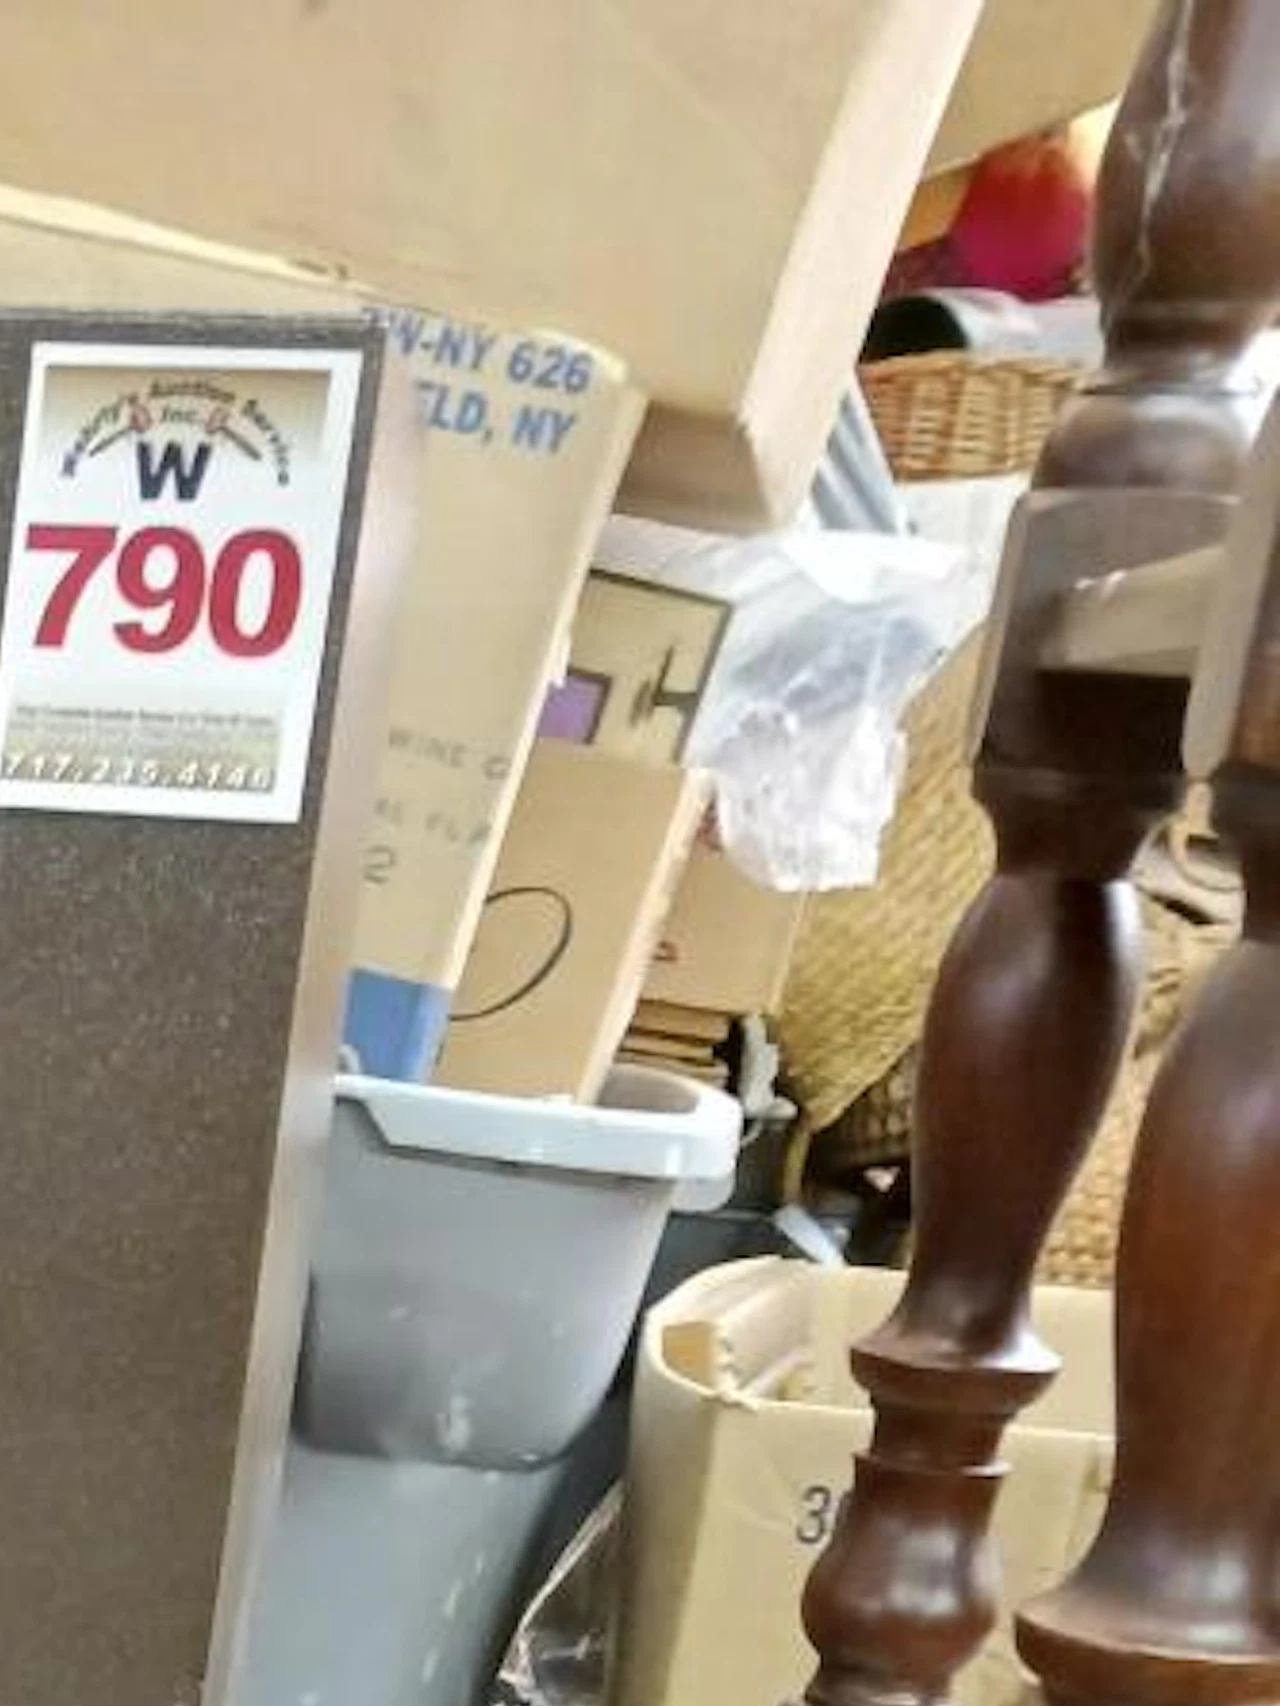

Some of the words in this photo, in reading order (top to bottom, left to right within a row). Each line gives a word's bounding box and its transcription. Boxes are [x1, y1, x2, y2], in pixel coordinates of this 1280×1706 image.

[366, 307, 500, 370] W-NY
[507, 338, 593, 394] 626
[511, 402, 579, 454] NY
[137, 441, 213, 501] W
[25, 522, 302, 659] 790
